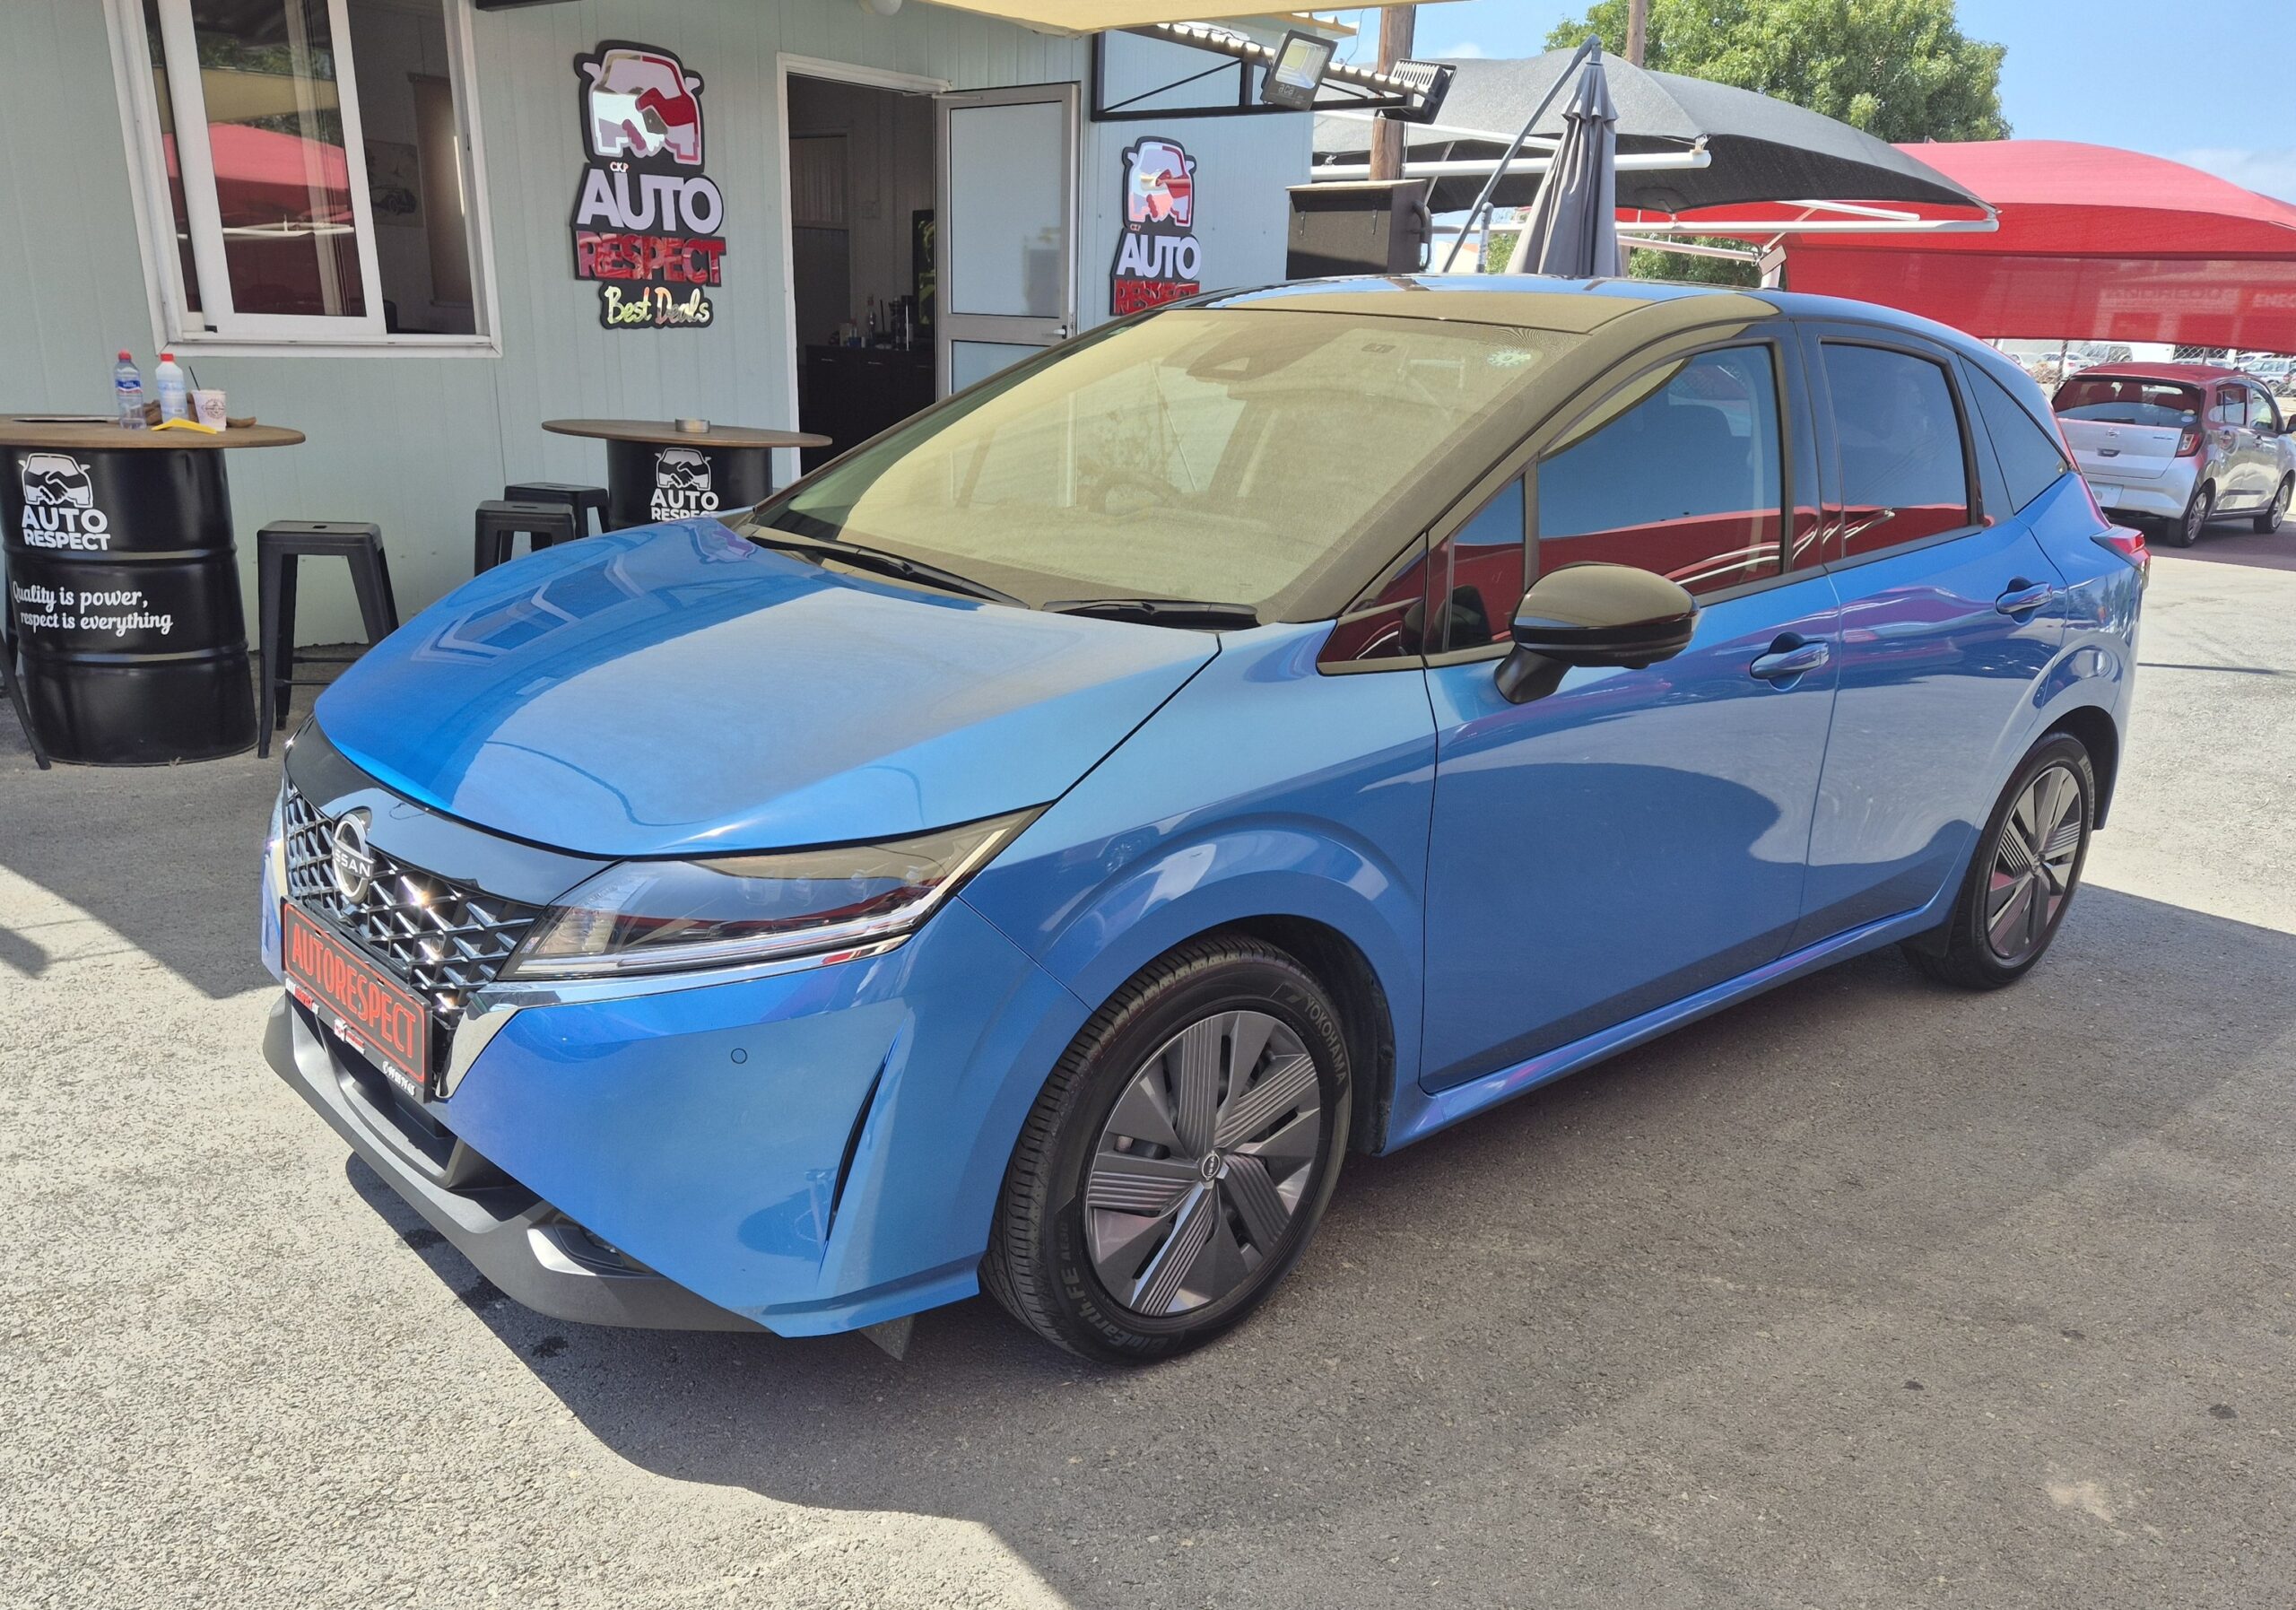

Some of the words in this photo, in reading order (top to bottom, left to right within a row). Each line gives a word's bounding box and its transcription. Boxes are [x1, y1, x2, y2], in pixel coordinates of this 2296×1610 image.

[577, 169, 724, 234] AUTO
[576, 231, 726, 284] RESPECT
[1116, 233, 1202, 280] AUTO
[604, 285, 653, 324] Best
[654, 286, 710, 324] Deals
[650, 488, 719, 510] AUTO
[22, 505, 108, 534] AUTO
[22, 528, 111, 551] RESPECT
[13, 580, 57, 613] Quality
[59, 587, 74, 605] is
[79, 590, 148, 614] power,
[20, 612, 60, 633] respect
[63, 613, 76, 629] is
[80, 612, 174, 638] everything
[291, 922, 417, 1060] AUTORESPECT
[1304, 993, 1347, 1086] YOKOHAMA
